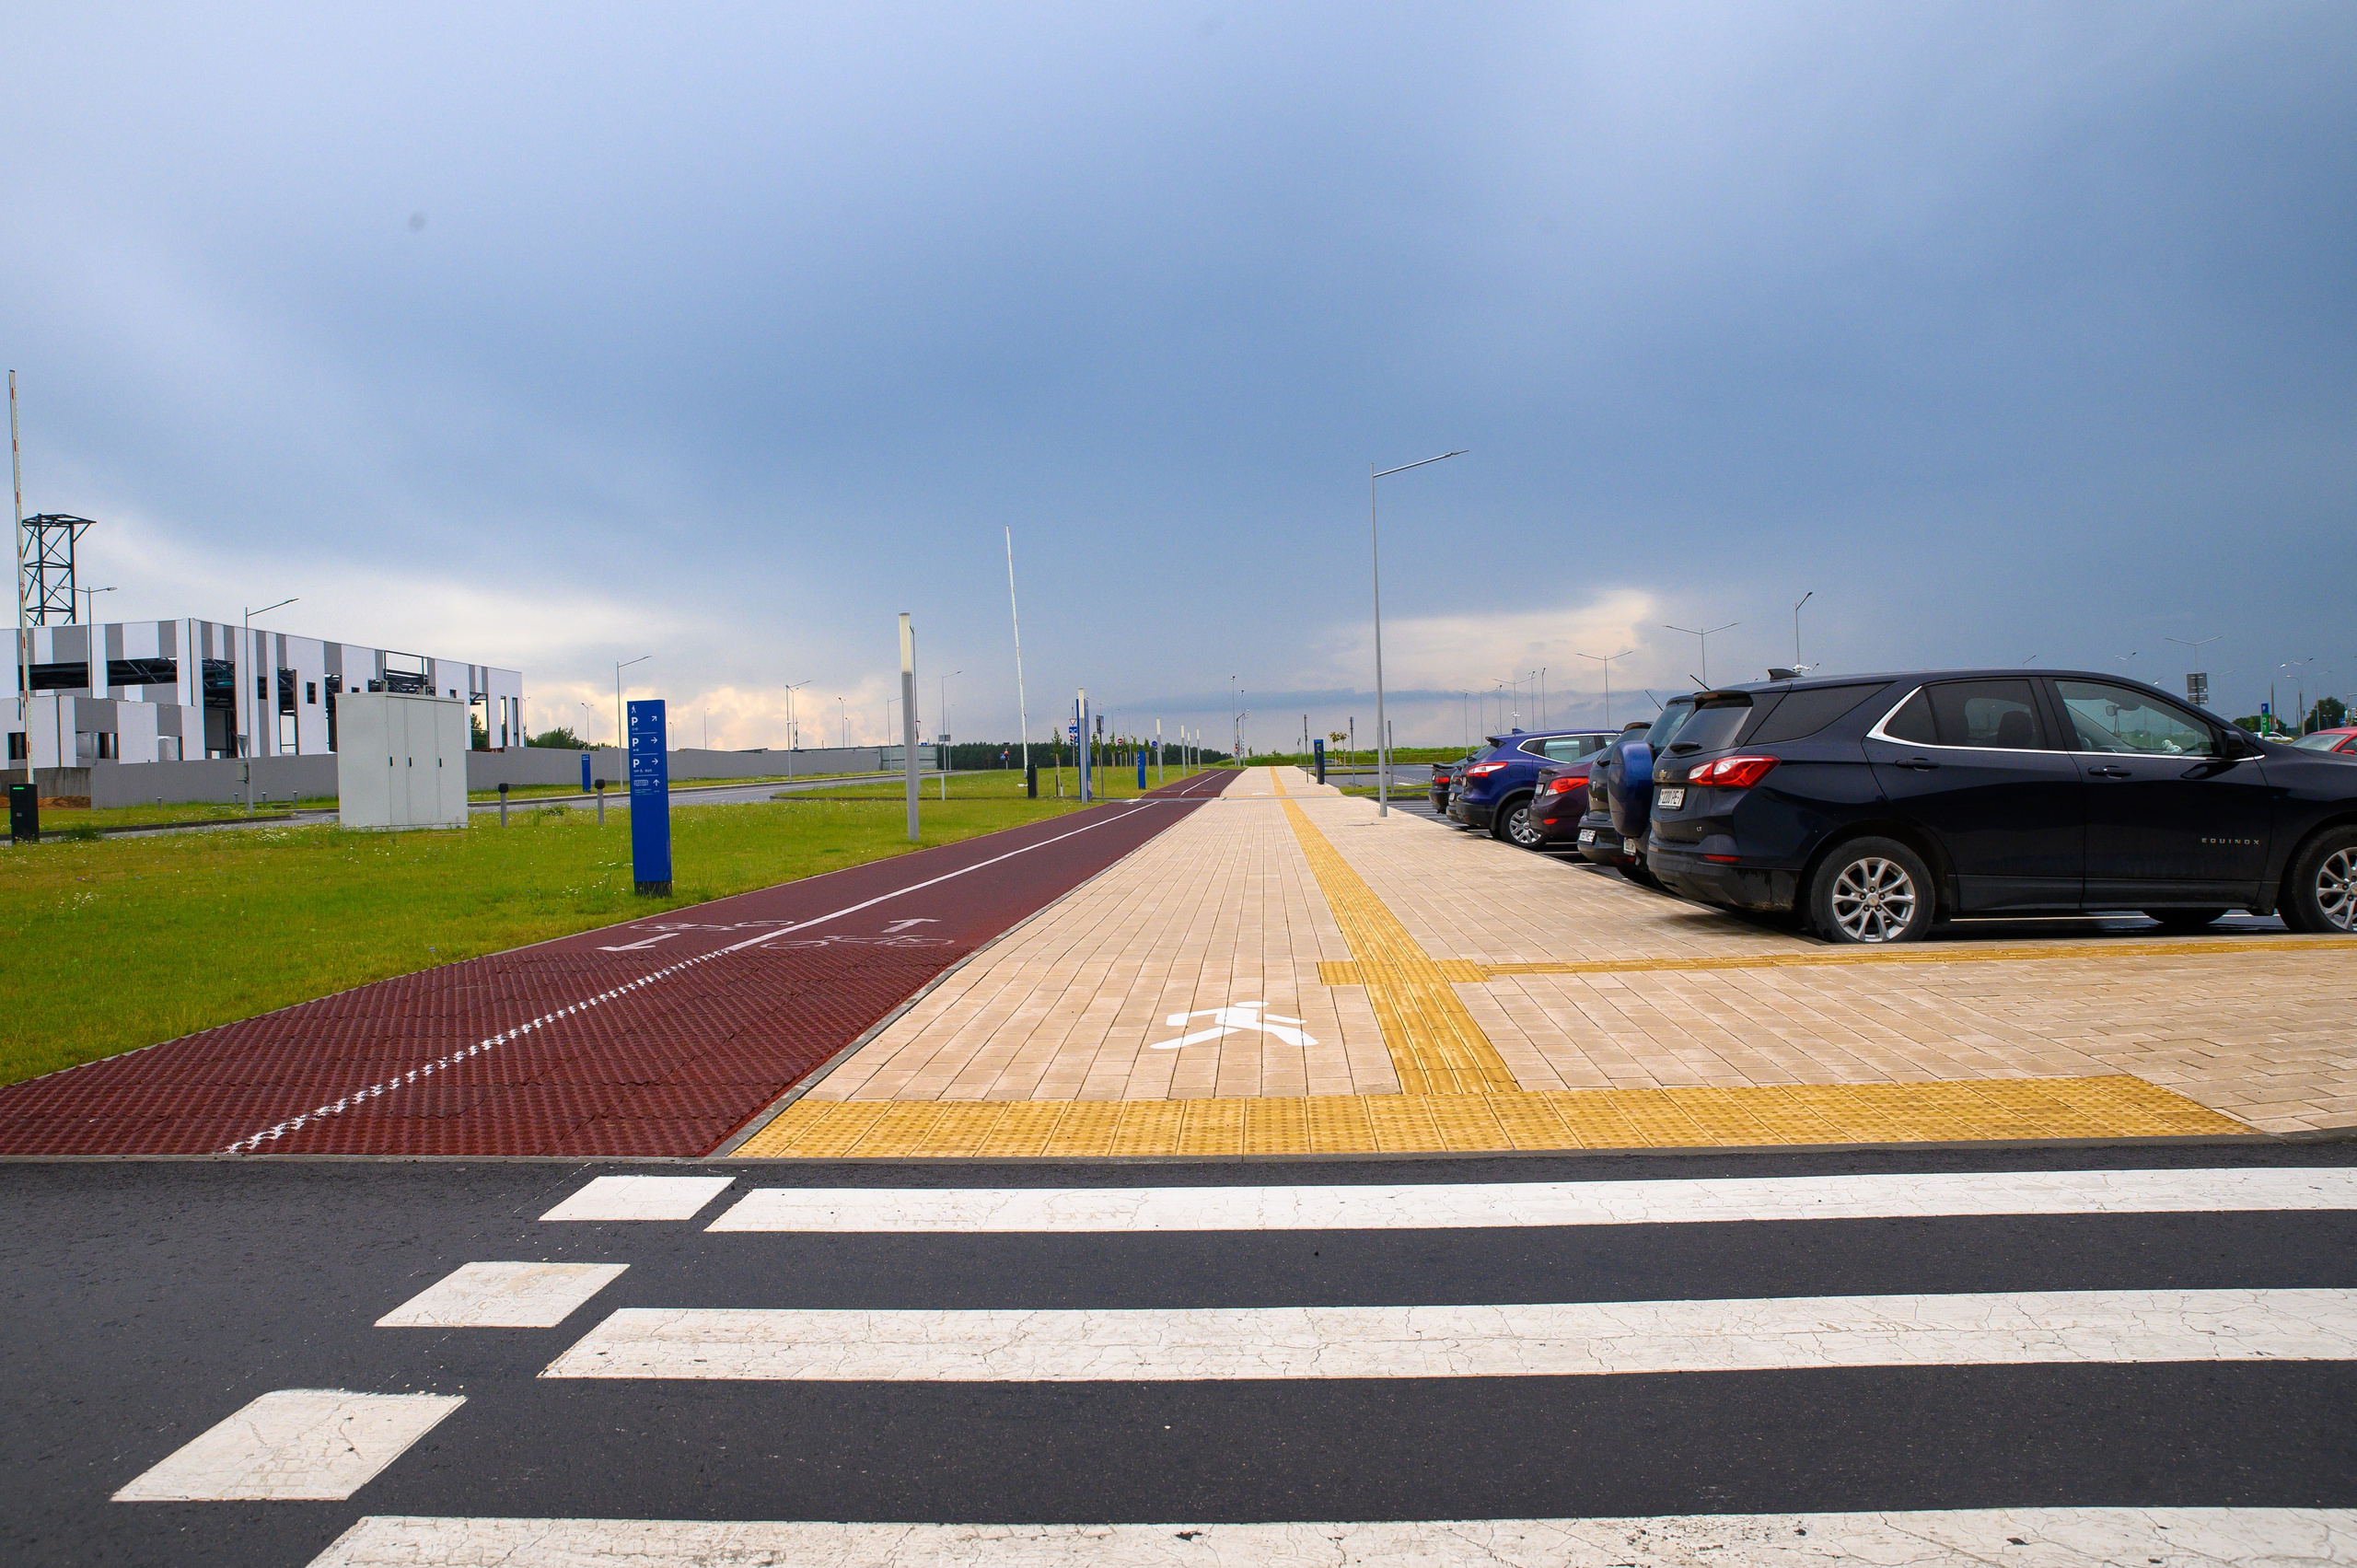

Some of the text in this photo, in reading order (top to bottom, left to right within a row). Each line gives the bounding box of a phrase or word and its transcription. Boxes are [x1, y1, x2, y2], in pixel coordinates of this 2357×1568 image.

[632, 716, 638, 726] P
[633, 738, 639, 747] P
[633, 759, 640, 768] P
